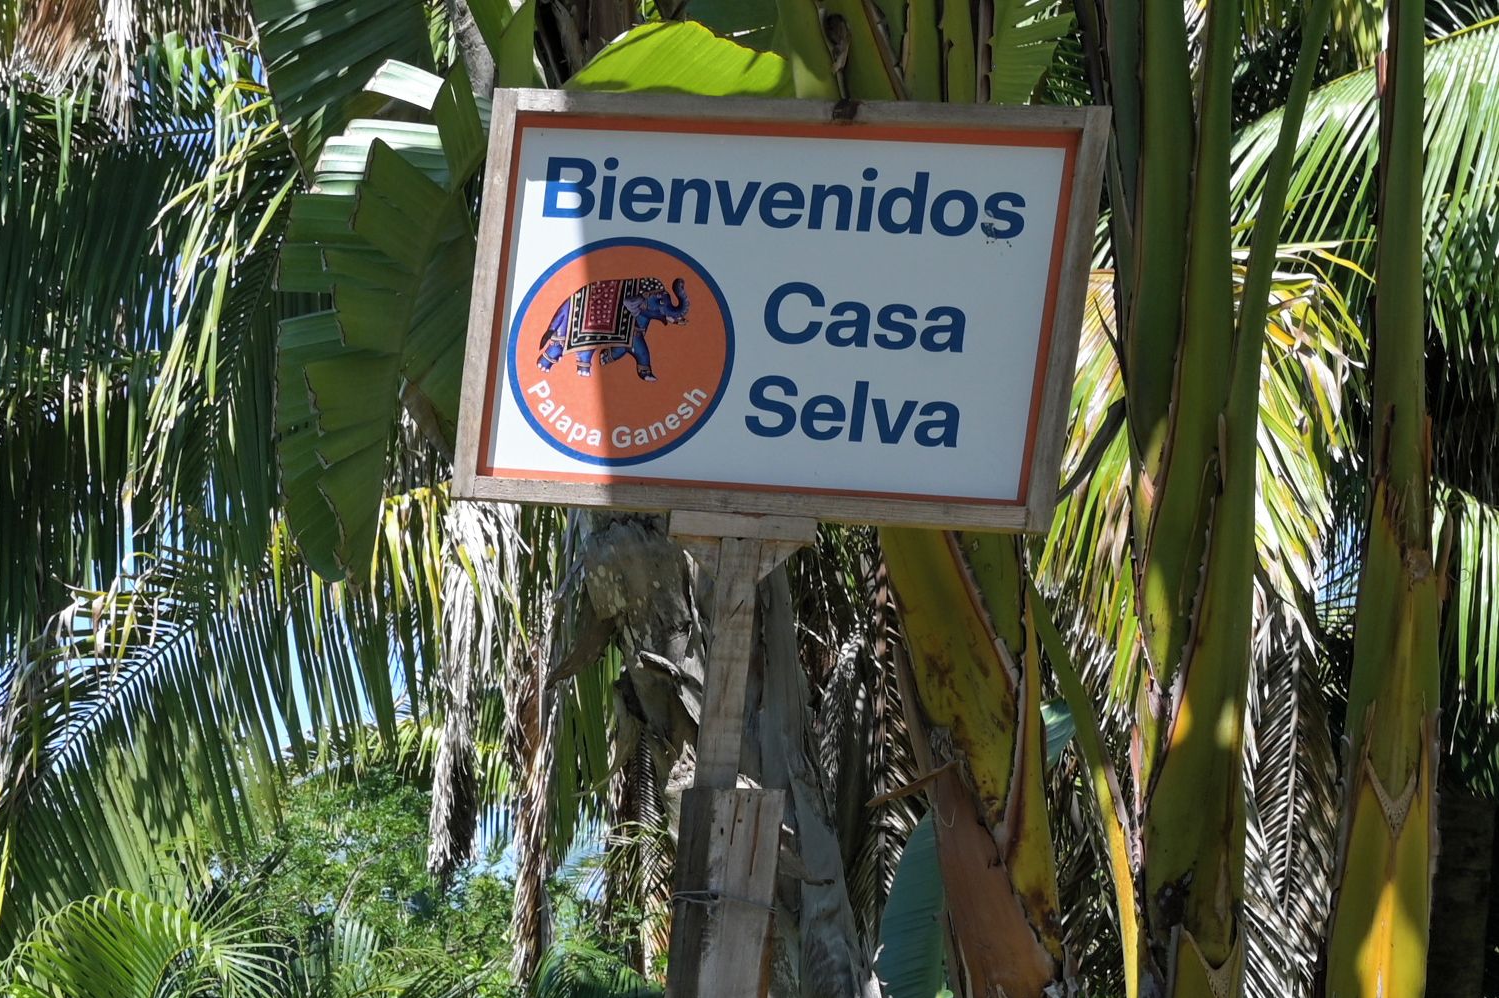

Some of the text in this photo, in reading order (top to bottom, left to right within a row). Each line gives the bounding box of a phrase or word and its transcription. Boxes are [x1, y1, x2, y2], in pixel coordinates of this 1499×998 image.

[542, 156, 1026, 240] Bienvenidos
[763, 281, 967, 353] Casa
[527, 379, 708, 448] Palapa Ganesh
[745, 375, 959, 448] Selva
